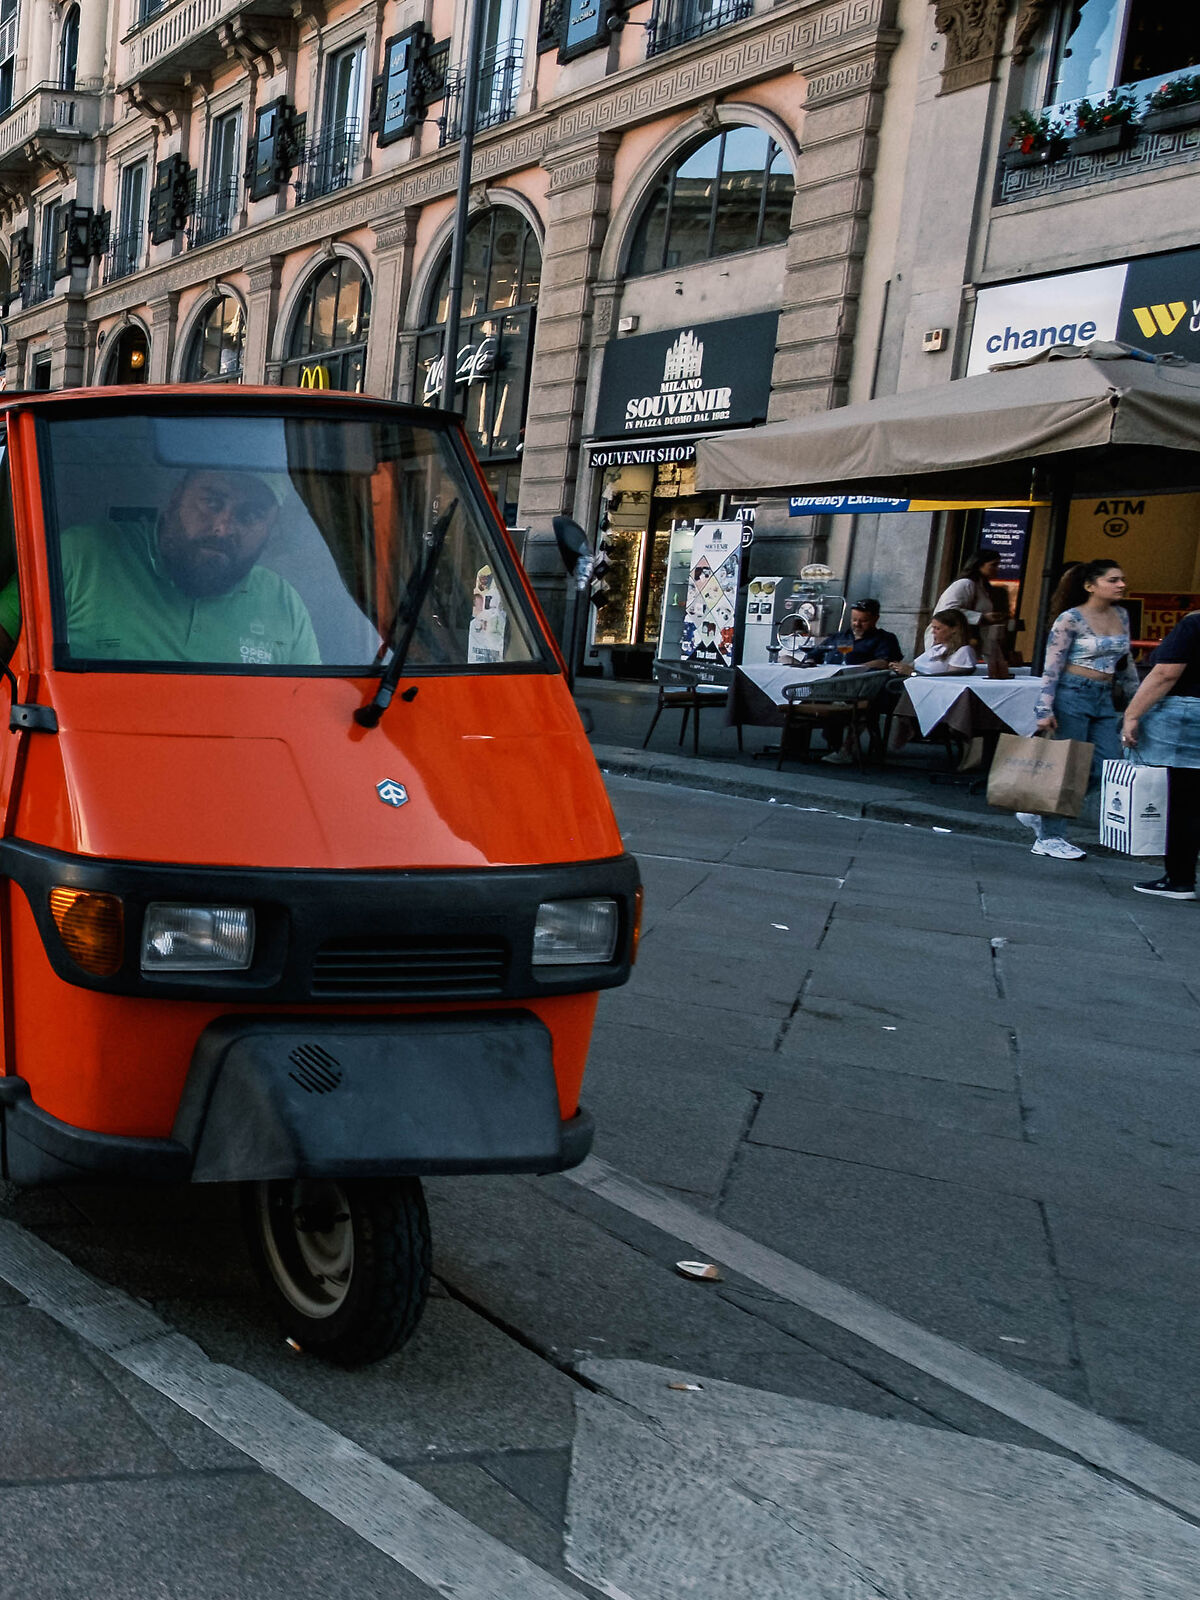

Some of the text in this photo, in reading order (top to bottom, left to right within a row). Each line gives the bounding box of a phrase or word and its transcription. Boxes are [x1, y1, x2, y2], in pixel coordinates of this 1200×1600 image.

[986, 320, 1097, 353] change
[660, 378, 703, 394] MILANO
[625, 387, 732, 420] SOUVENIR
[634, 418, 662, 429] PIAZZA
[664, 415, 692, 425] DUOMO
[693, 413, 710, 423] DAL
[591, 445, 696, 467] SOUVENIR SHOP
[1093, 500, 1146, 516] ATM
